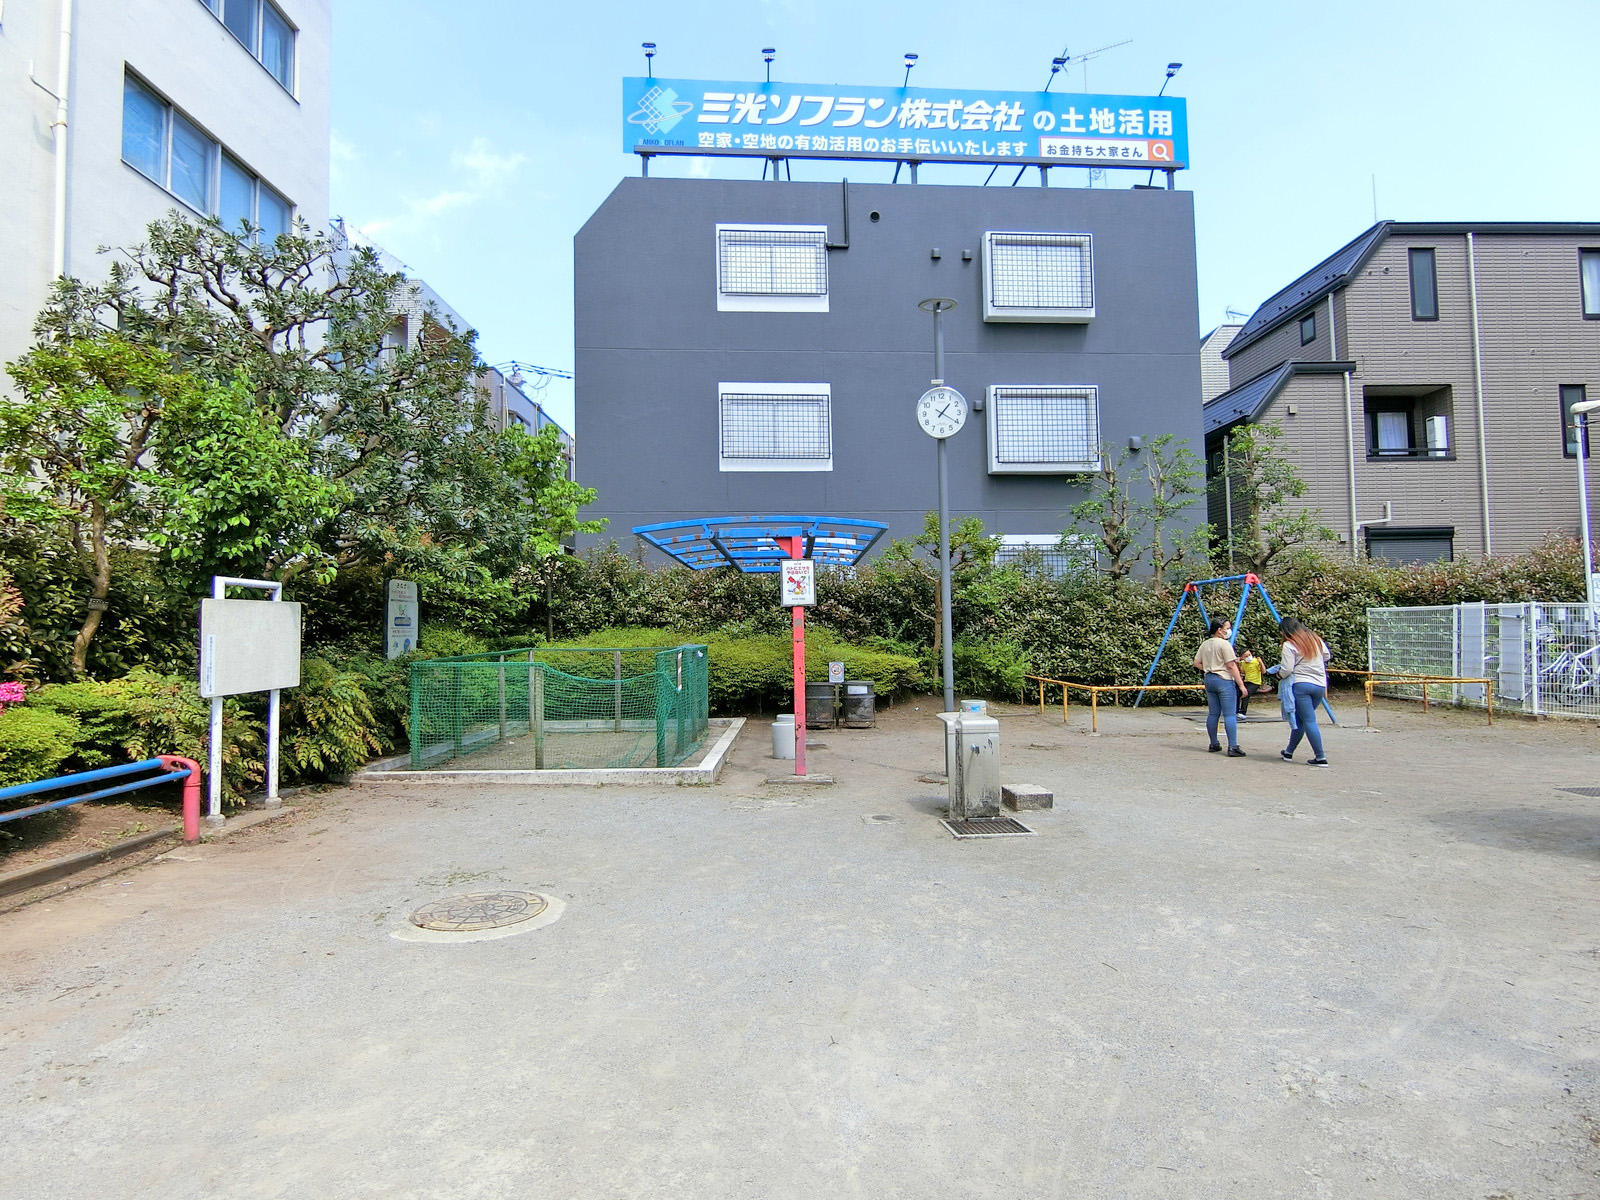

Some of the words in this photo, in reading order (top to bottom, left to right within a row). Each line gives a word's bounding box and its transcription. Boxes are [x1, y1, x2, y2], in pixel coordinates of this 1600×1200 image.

[697, 91, 1026, 132] 三光ソフラン株式会社
[1033, 106, 1173, 136] の土地活用
[1046, 143, 1143, 158] お金持ち大家さん
